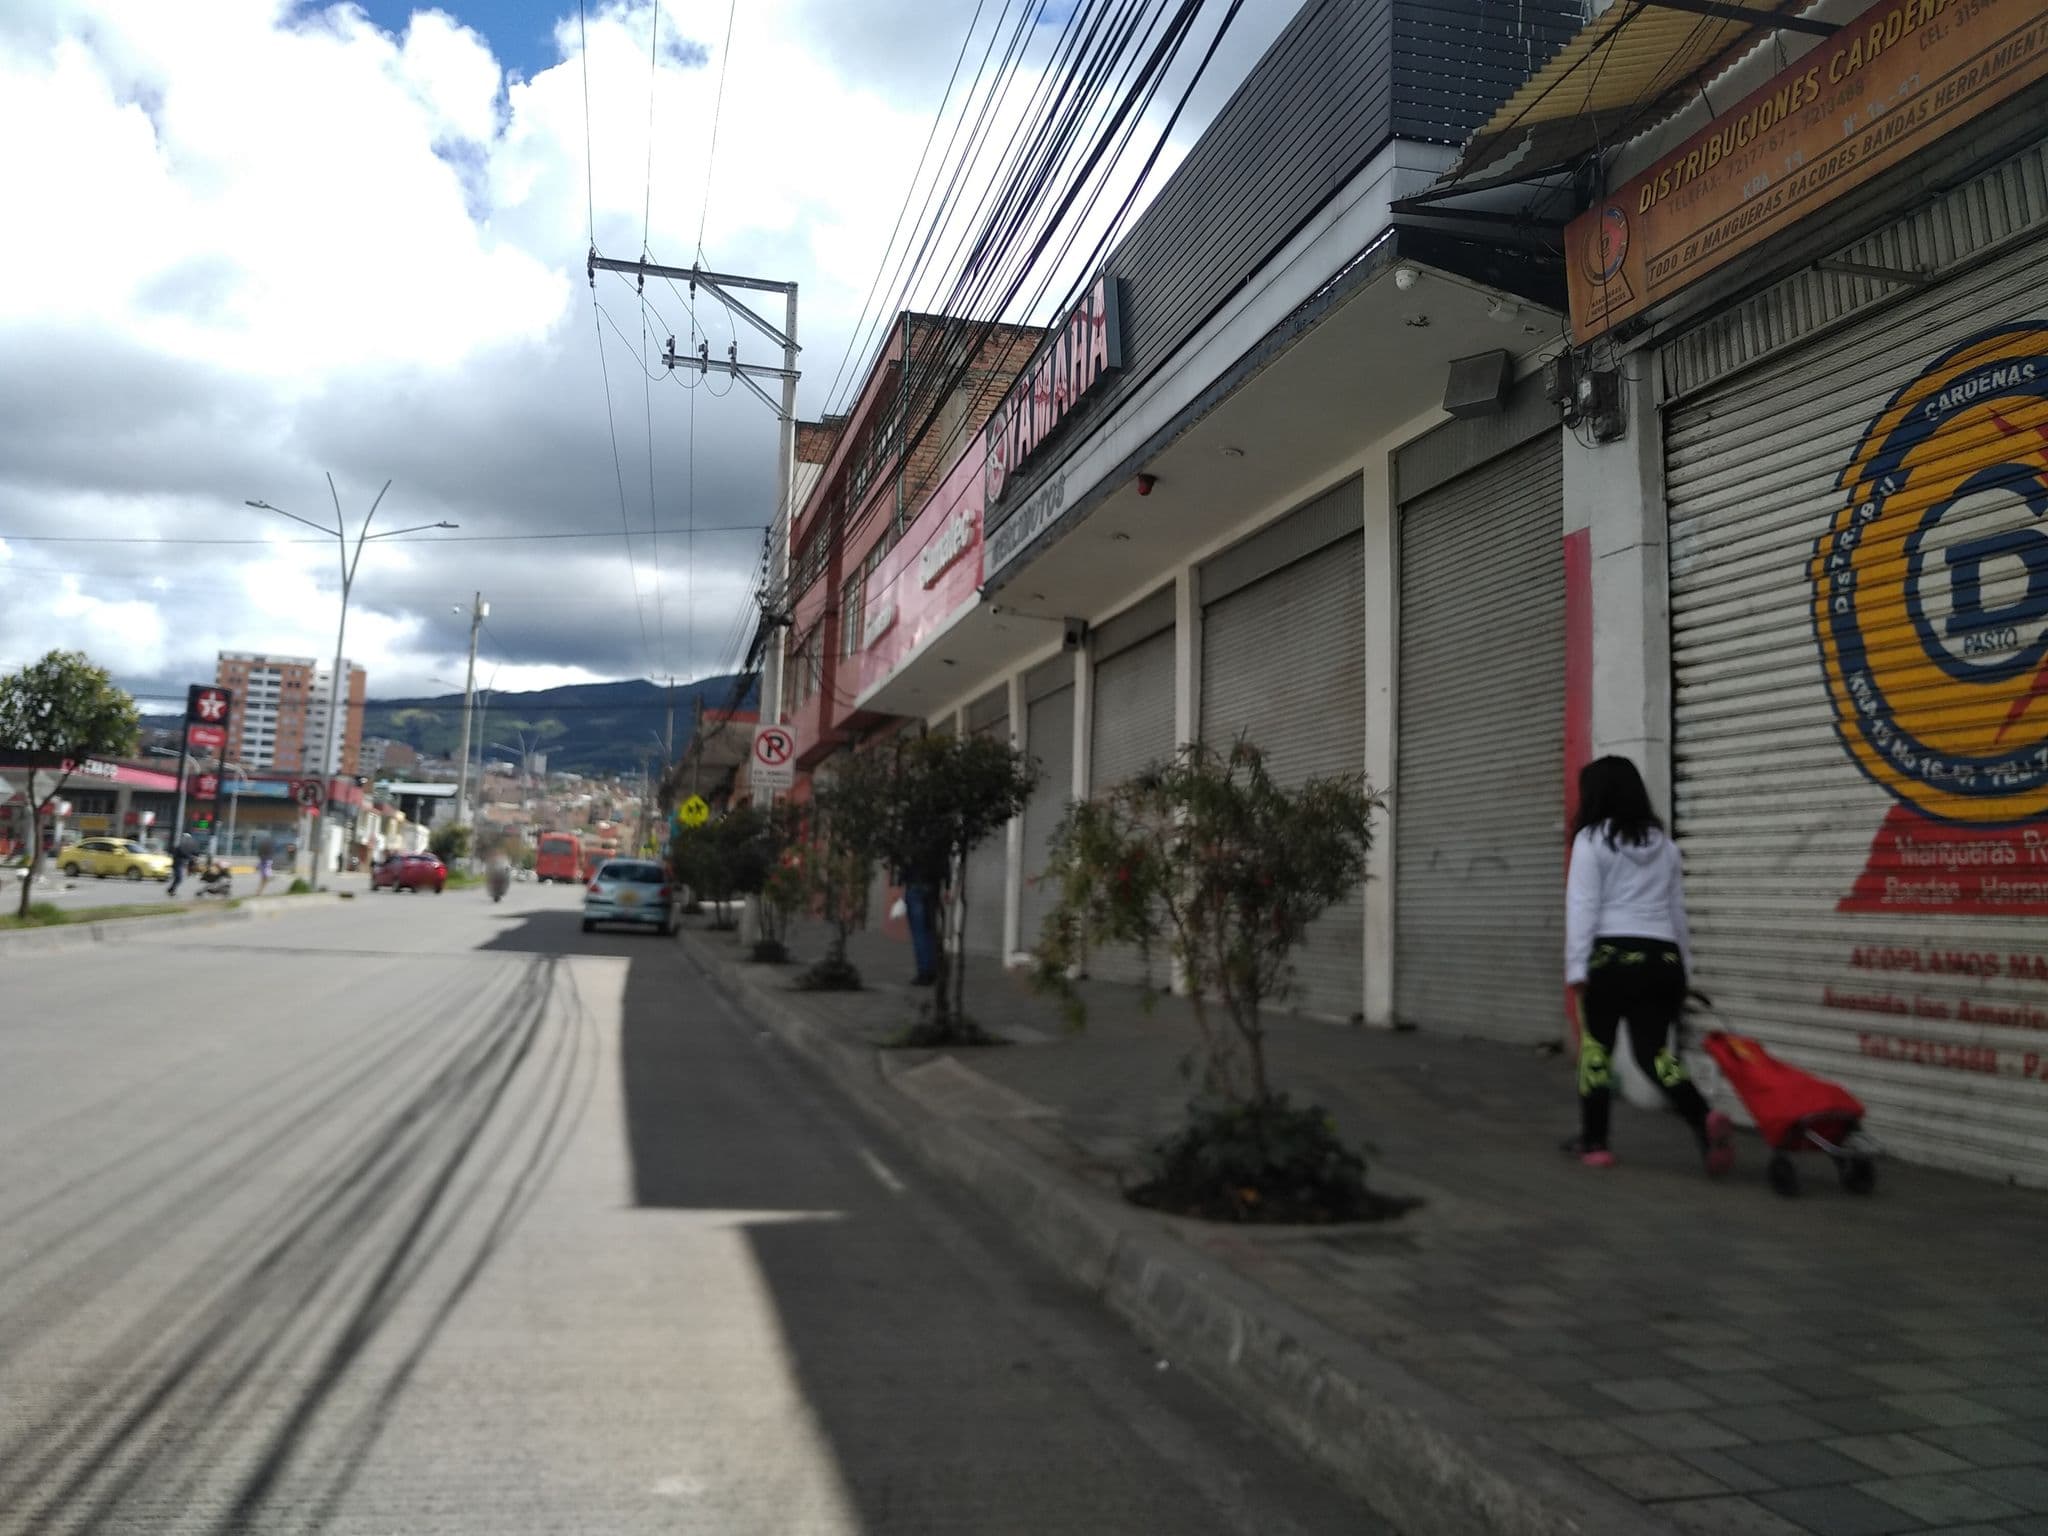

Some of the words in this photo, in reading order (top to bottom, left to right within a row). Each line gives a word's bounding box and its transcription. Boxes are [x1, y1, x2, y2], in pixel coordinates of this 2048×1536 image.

[1638, 66, 1820, 215] DISTRIBUCIONES
[1649, 254, 1678, 281] TODO
[1683, 242, 1699, 262] EN
[1702, 190, 1783, 252] MANGUERAS
[1788, 145, 1858, 200] RACORES
[1860, 99, 1929, 152] BANDAS
[1005, 277, 1109, 476] YAMAHA
[1924, 363, 2036, 421] CARDENAS
[1964, 627, 2018, 655] PASTO
